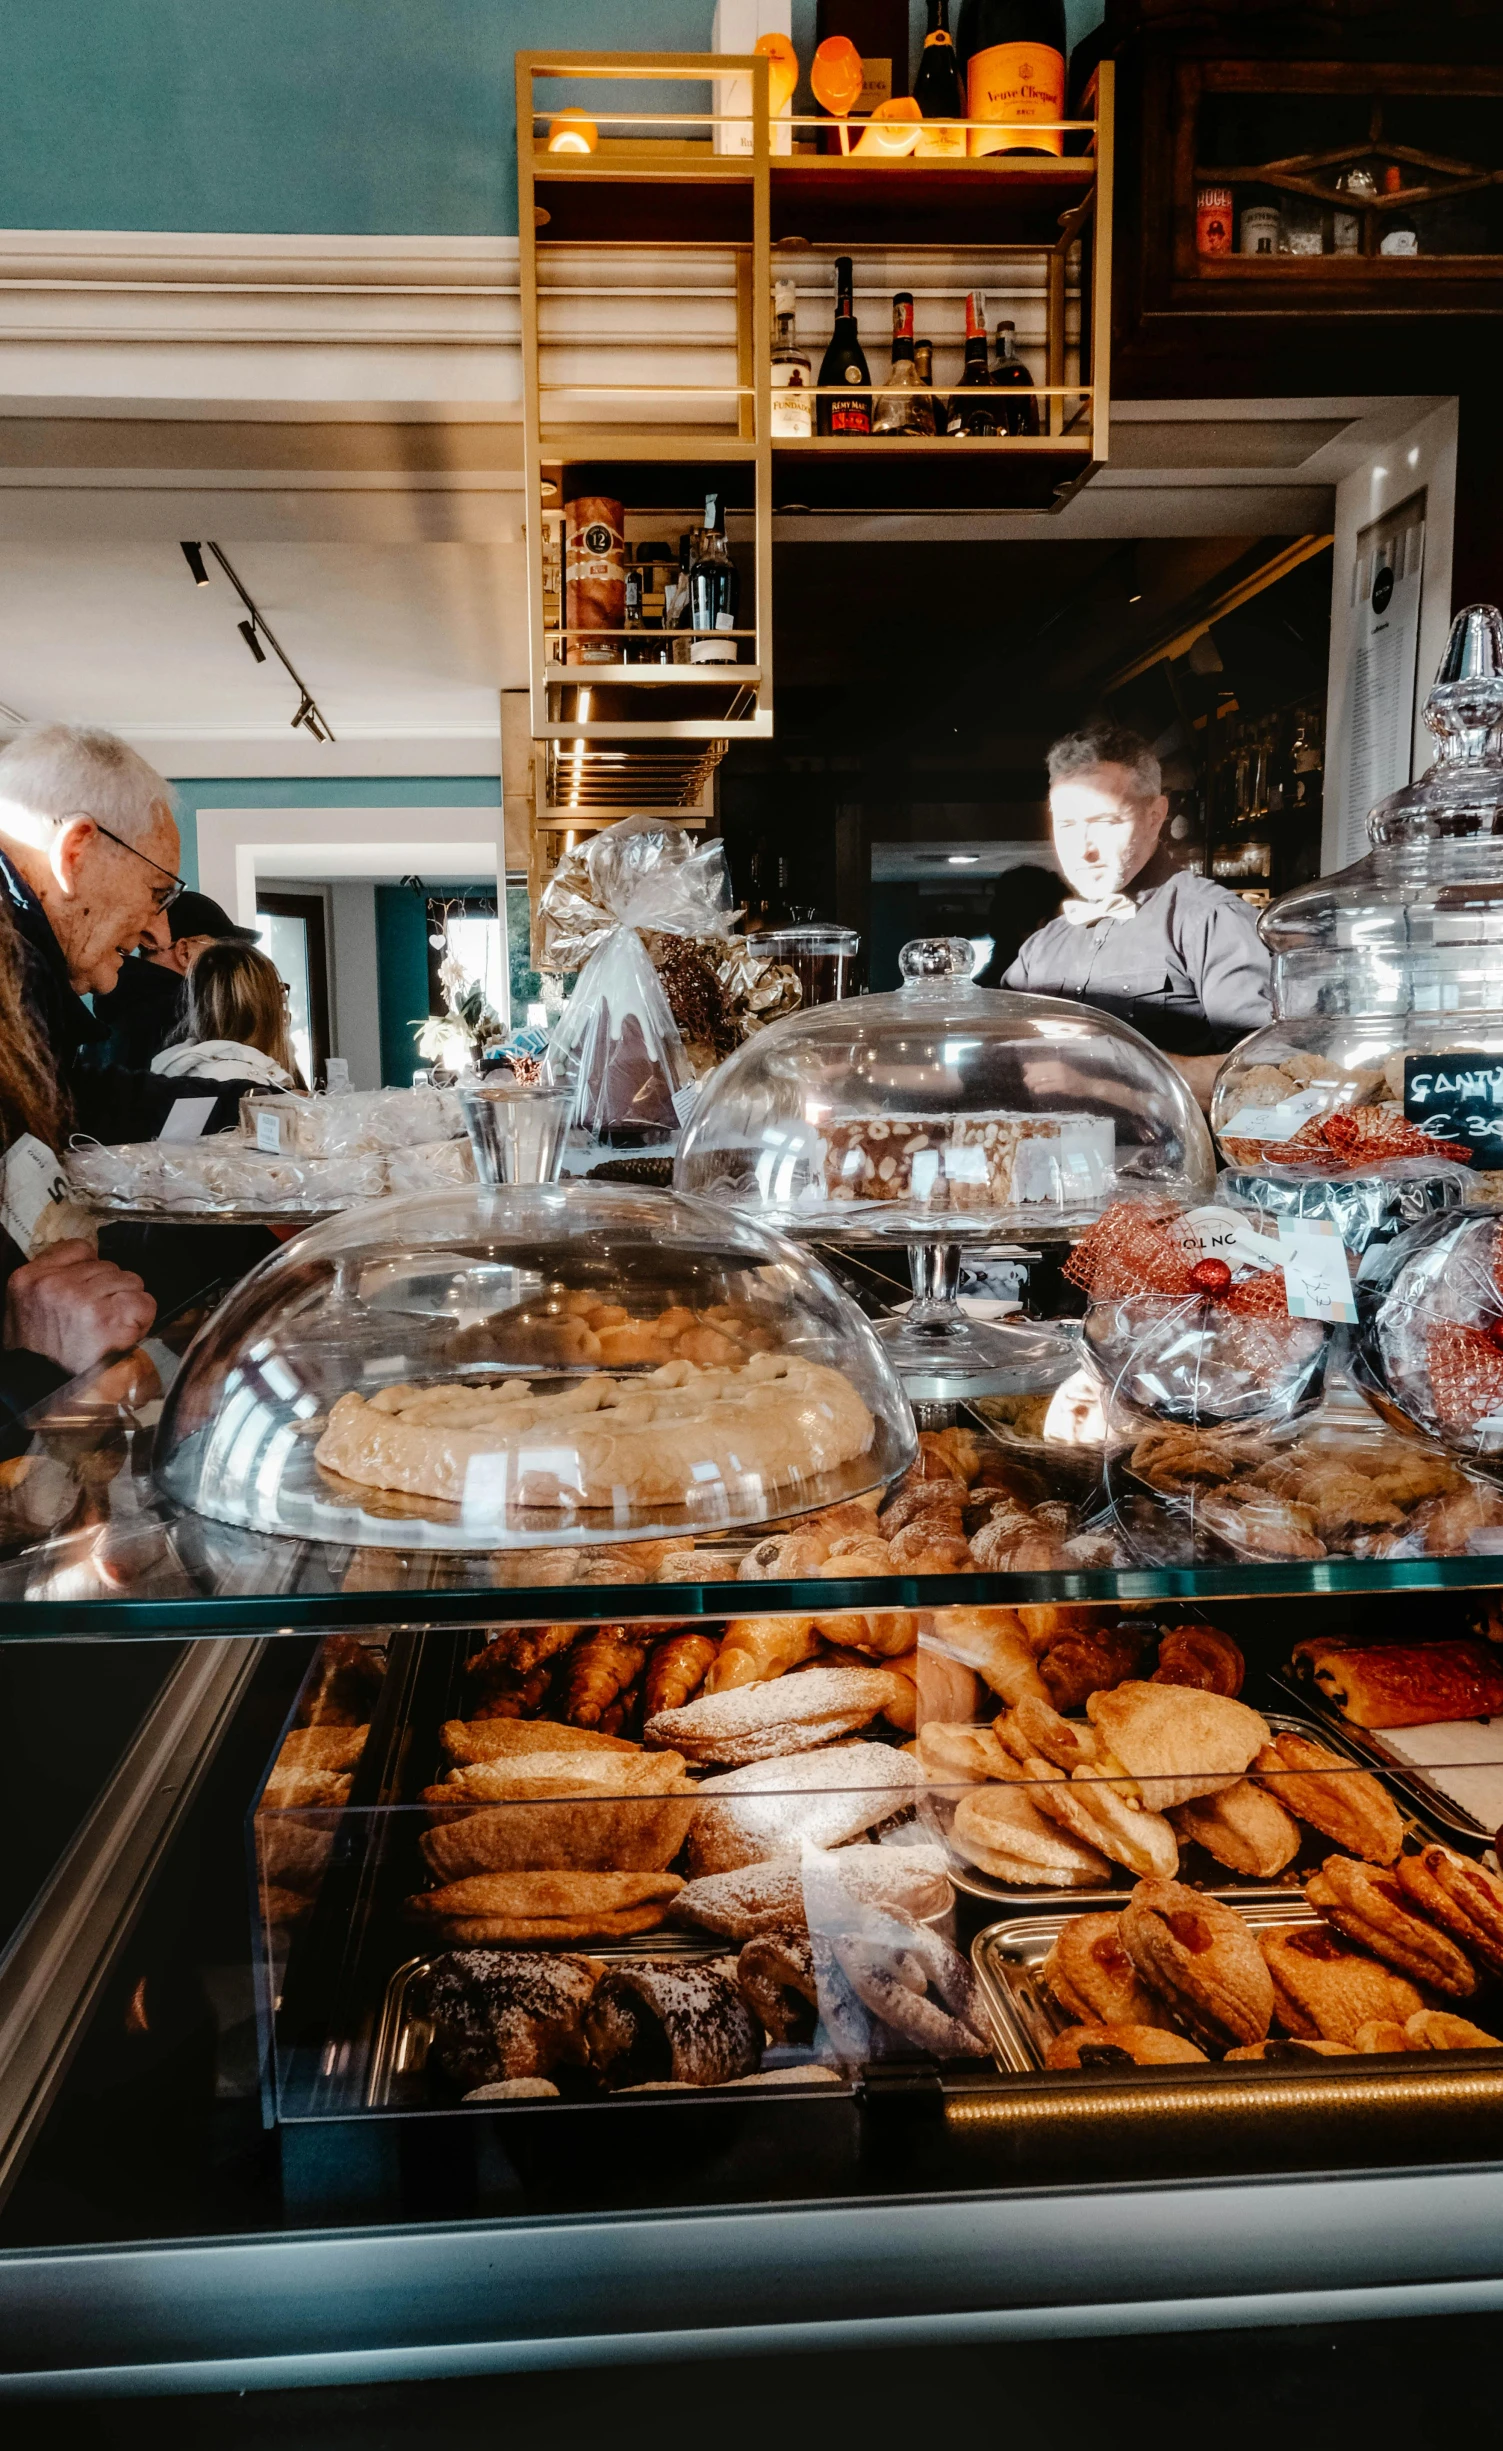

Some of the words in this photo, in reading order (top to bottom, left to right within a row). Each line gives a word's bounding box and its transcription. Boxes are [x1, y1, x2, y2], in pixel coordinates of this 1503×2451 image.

[988, 89, 1018, 102] Veuve
[593, 533, 606, 547] 12
[47, 1177, 67, 1205] 5
